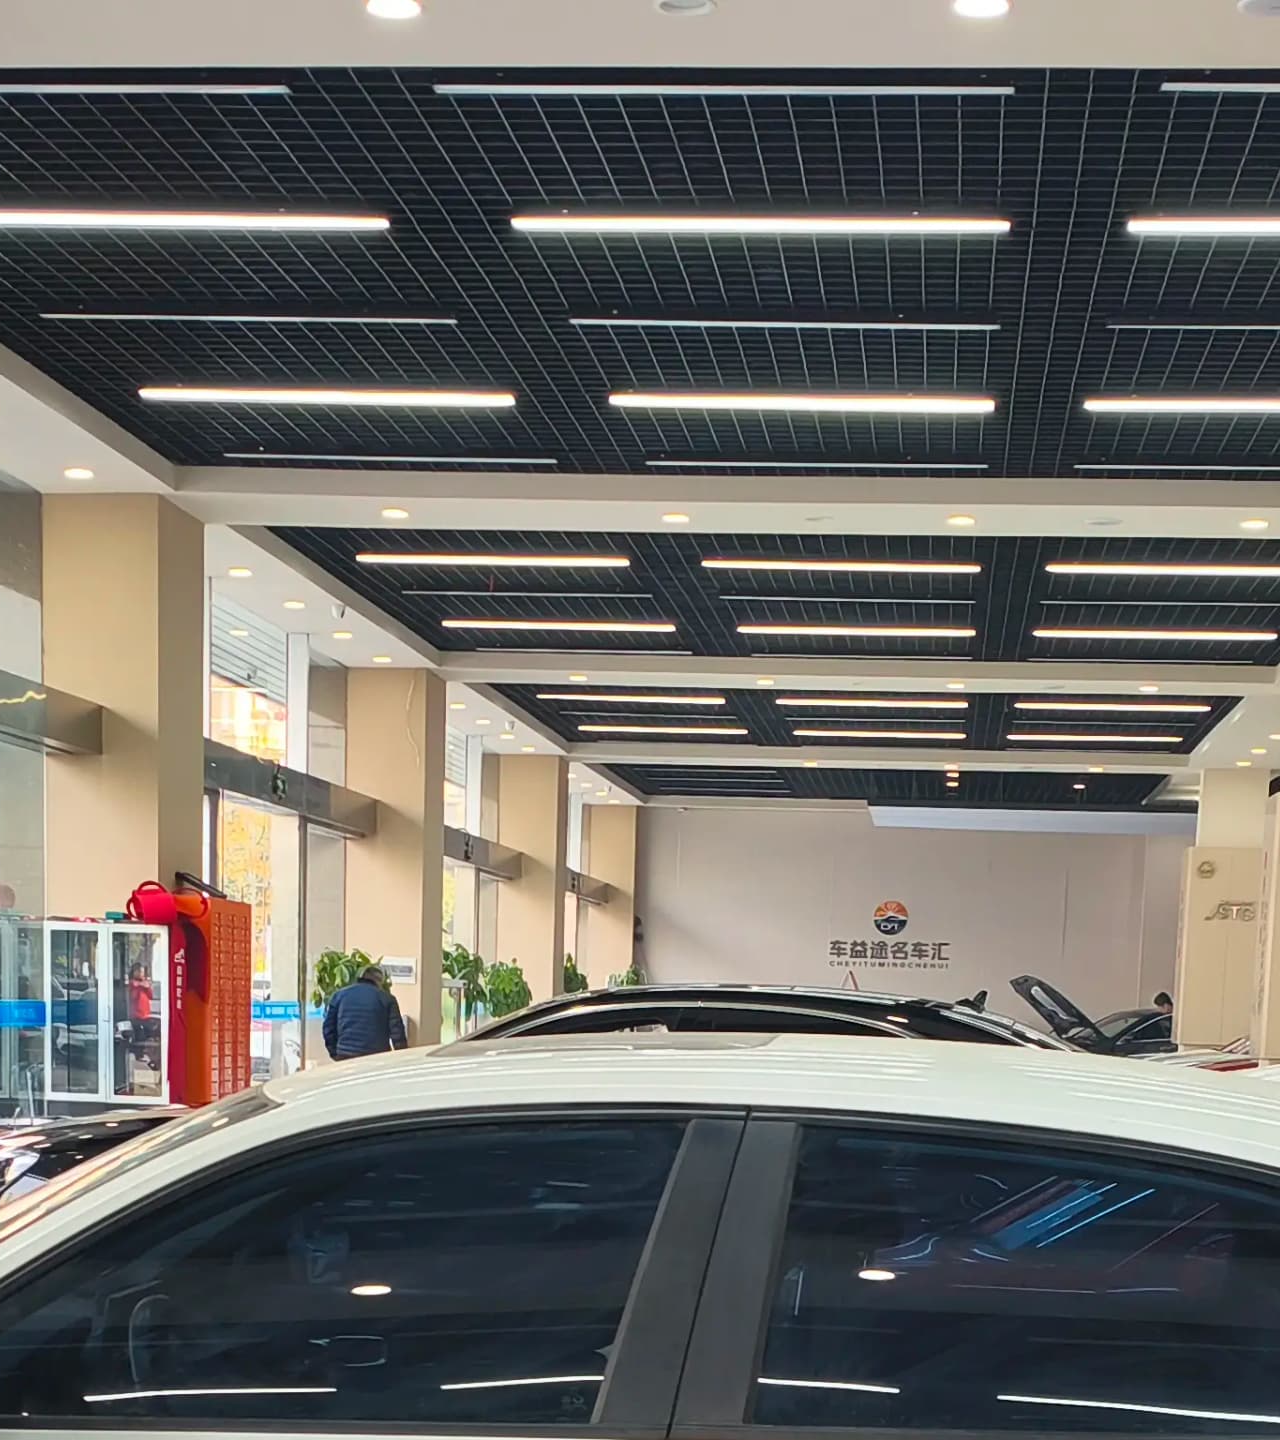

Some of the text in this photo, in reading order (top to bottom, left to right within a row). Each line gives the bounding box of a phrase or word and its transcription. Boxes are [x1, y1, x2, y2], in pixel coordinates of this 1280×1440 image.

[829, 940, 950, 960] 车益途名车汇
